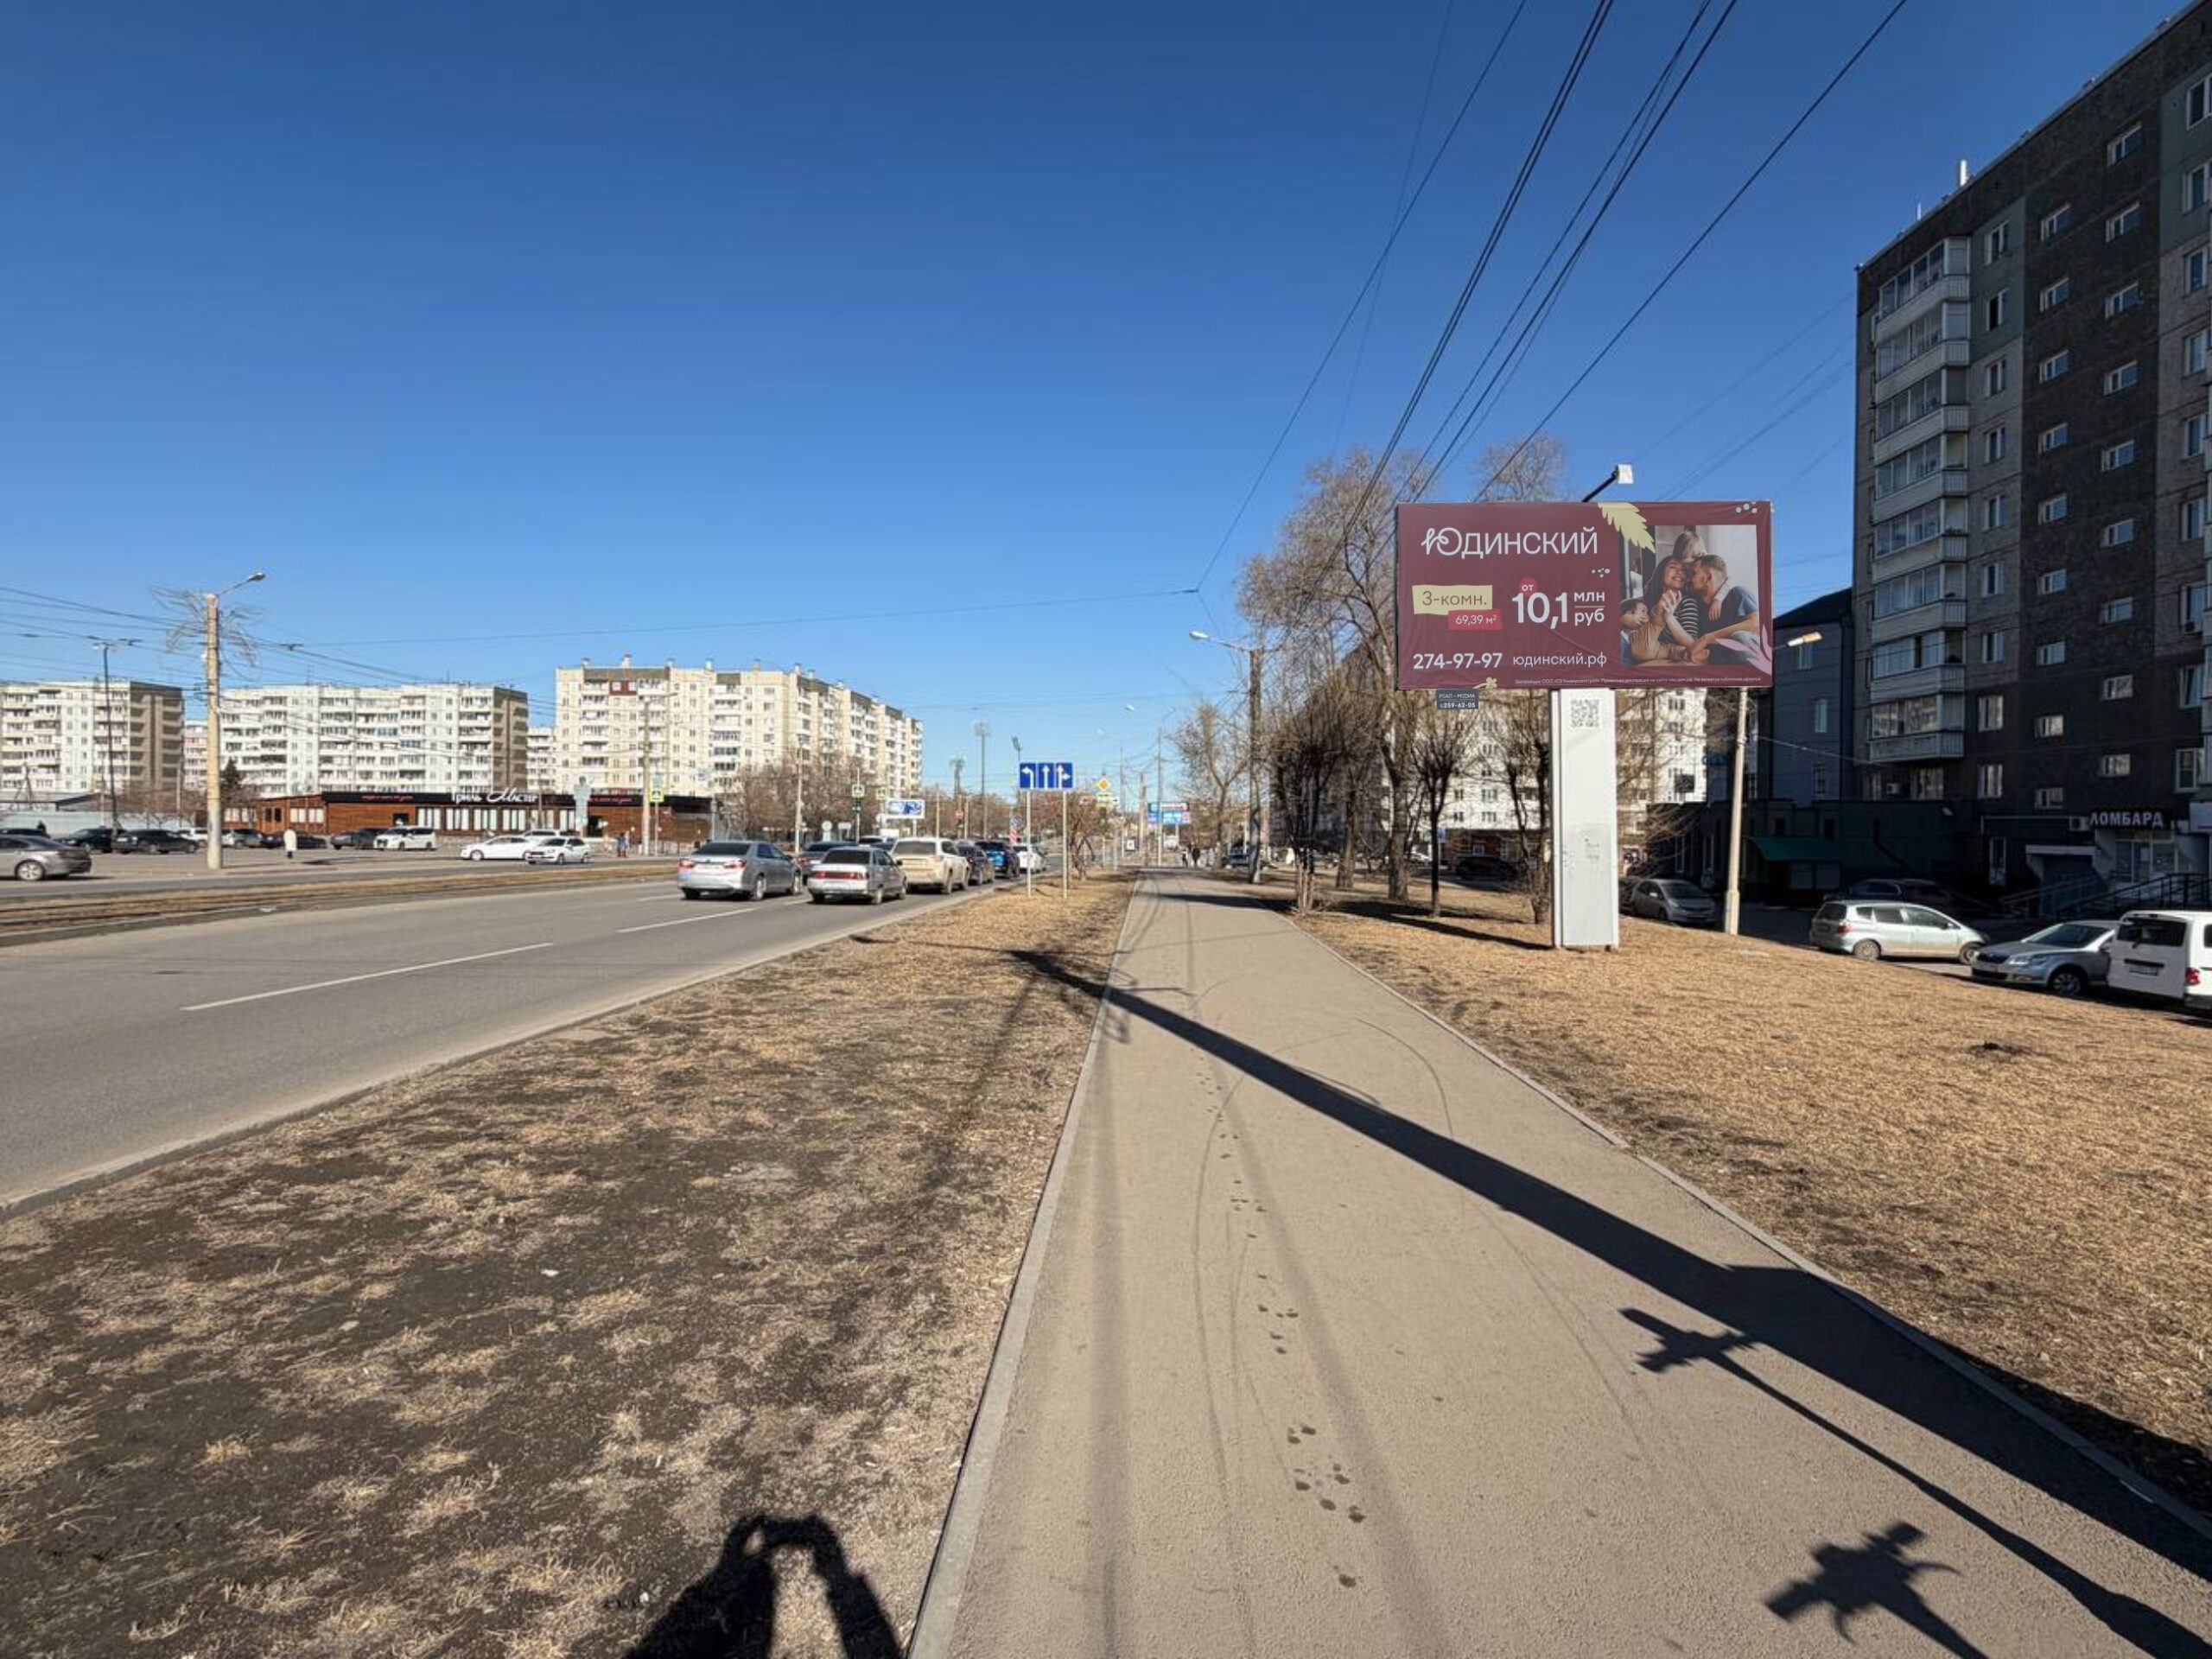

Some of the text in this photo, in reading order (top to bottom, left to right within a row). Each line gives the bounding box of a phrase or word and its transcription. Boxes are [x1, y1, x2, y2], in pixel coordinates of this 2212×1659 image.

[1422, 591, 1487, 606] 3-комн.
[1573, 592, 1605, 601] млн
[1512, 592, 1567, 629] 10,1
[1574, 607, 1605, 626] руб
[1455, 614, 1484, 626] 69,39
[1413, 652, 1503, 670] 274-97-97
[1513, 652, 1607, 668] юдинский.рф
[2090, 811, 2164, 829] ЛОМБАРД
